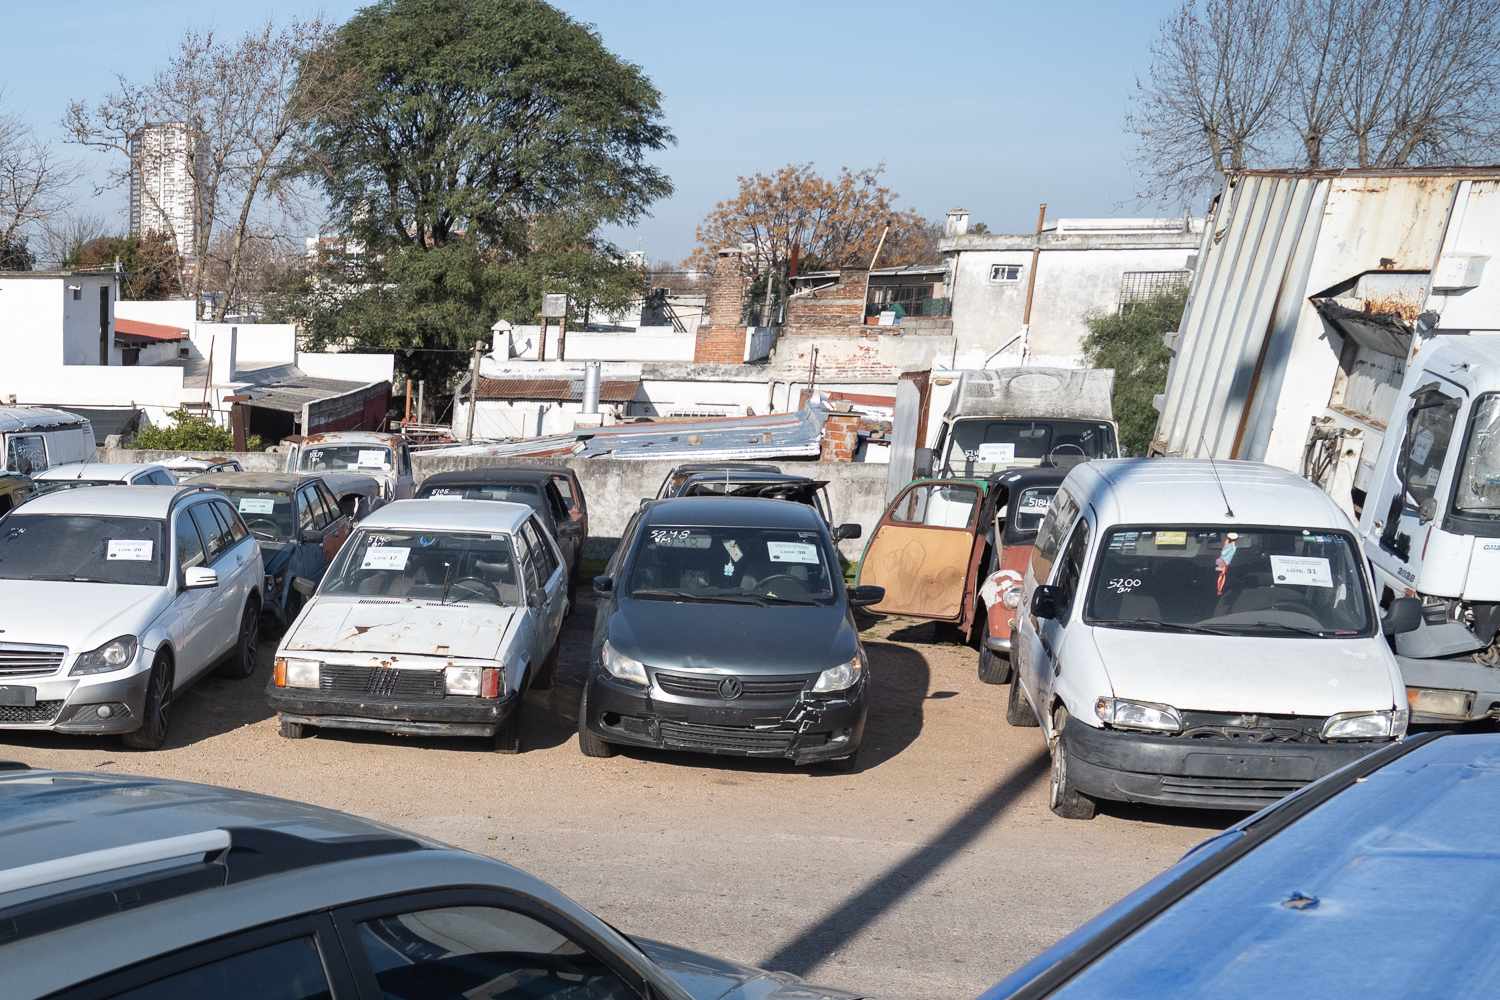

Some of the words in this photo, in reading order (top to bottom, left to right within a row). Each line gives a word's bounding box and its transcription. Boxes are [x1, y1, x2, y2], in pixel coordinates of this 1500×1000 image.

[1028, 498, 1050, 508] 5184
[650, 530, 690, 539] 5248
[1397, 567, 1415, 582] 2828
[1107, 579, 1141, 589] 5200
